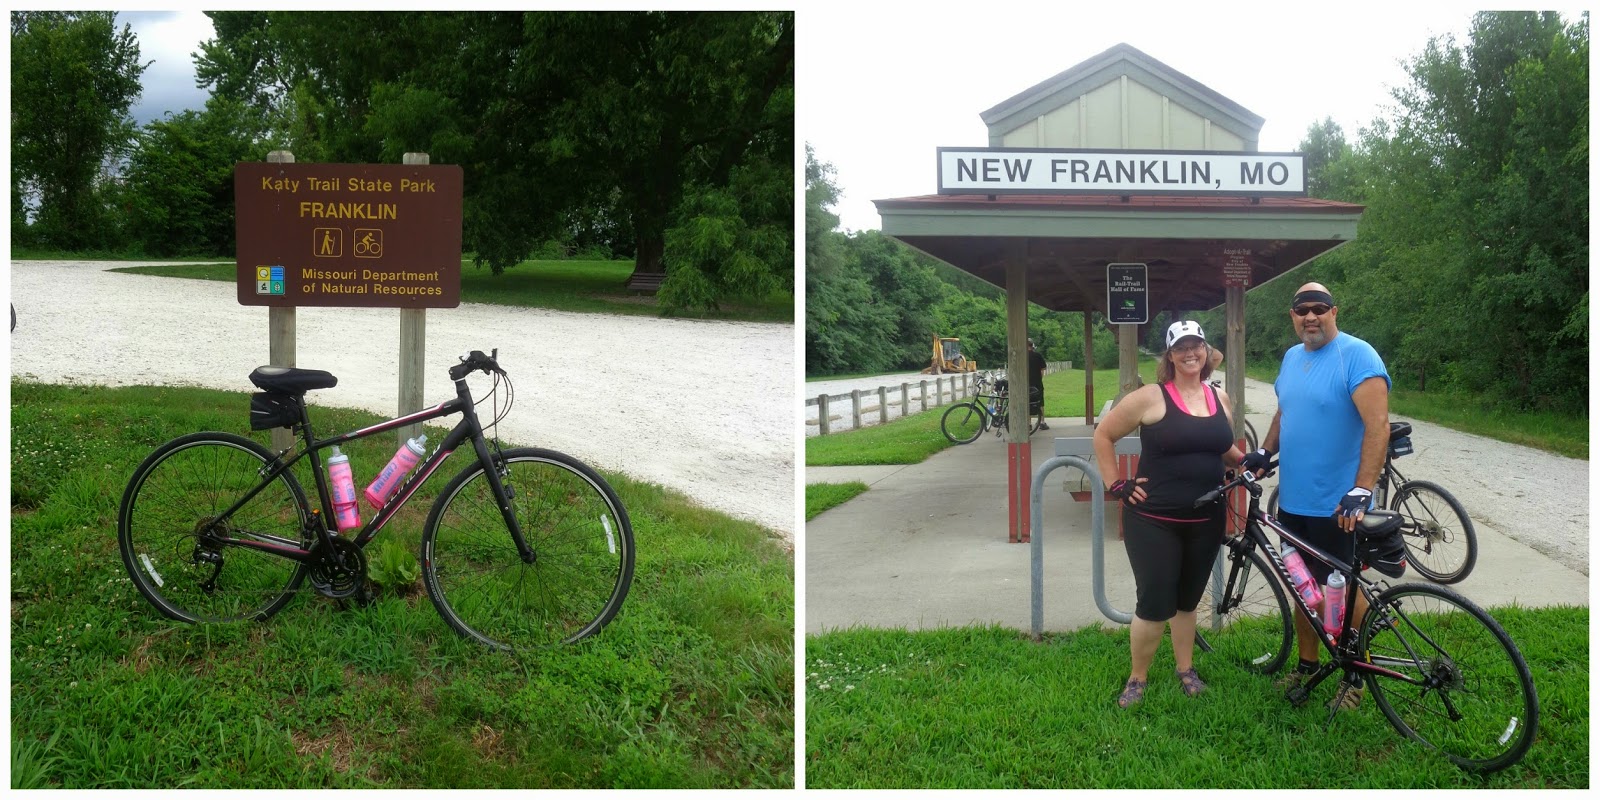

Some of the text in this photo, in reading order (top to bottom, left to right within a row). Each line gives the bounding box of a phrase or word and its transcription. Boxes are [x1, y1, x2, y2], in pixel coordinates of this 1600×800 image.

[956, 158, 1289, 189] NEW FRANKLIN, MO
[262, 177, 436, 193] Katy Trail State Park
[300, 202, 397, 220] FRANKLIN
[302, 268, 439, 282] Missouri Department
[302, 283, 442, 295] of Natural Resources
